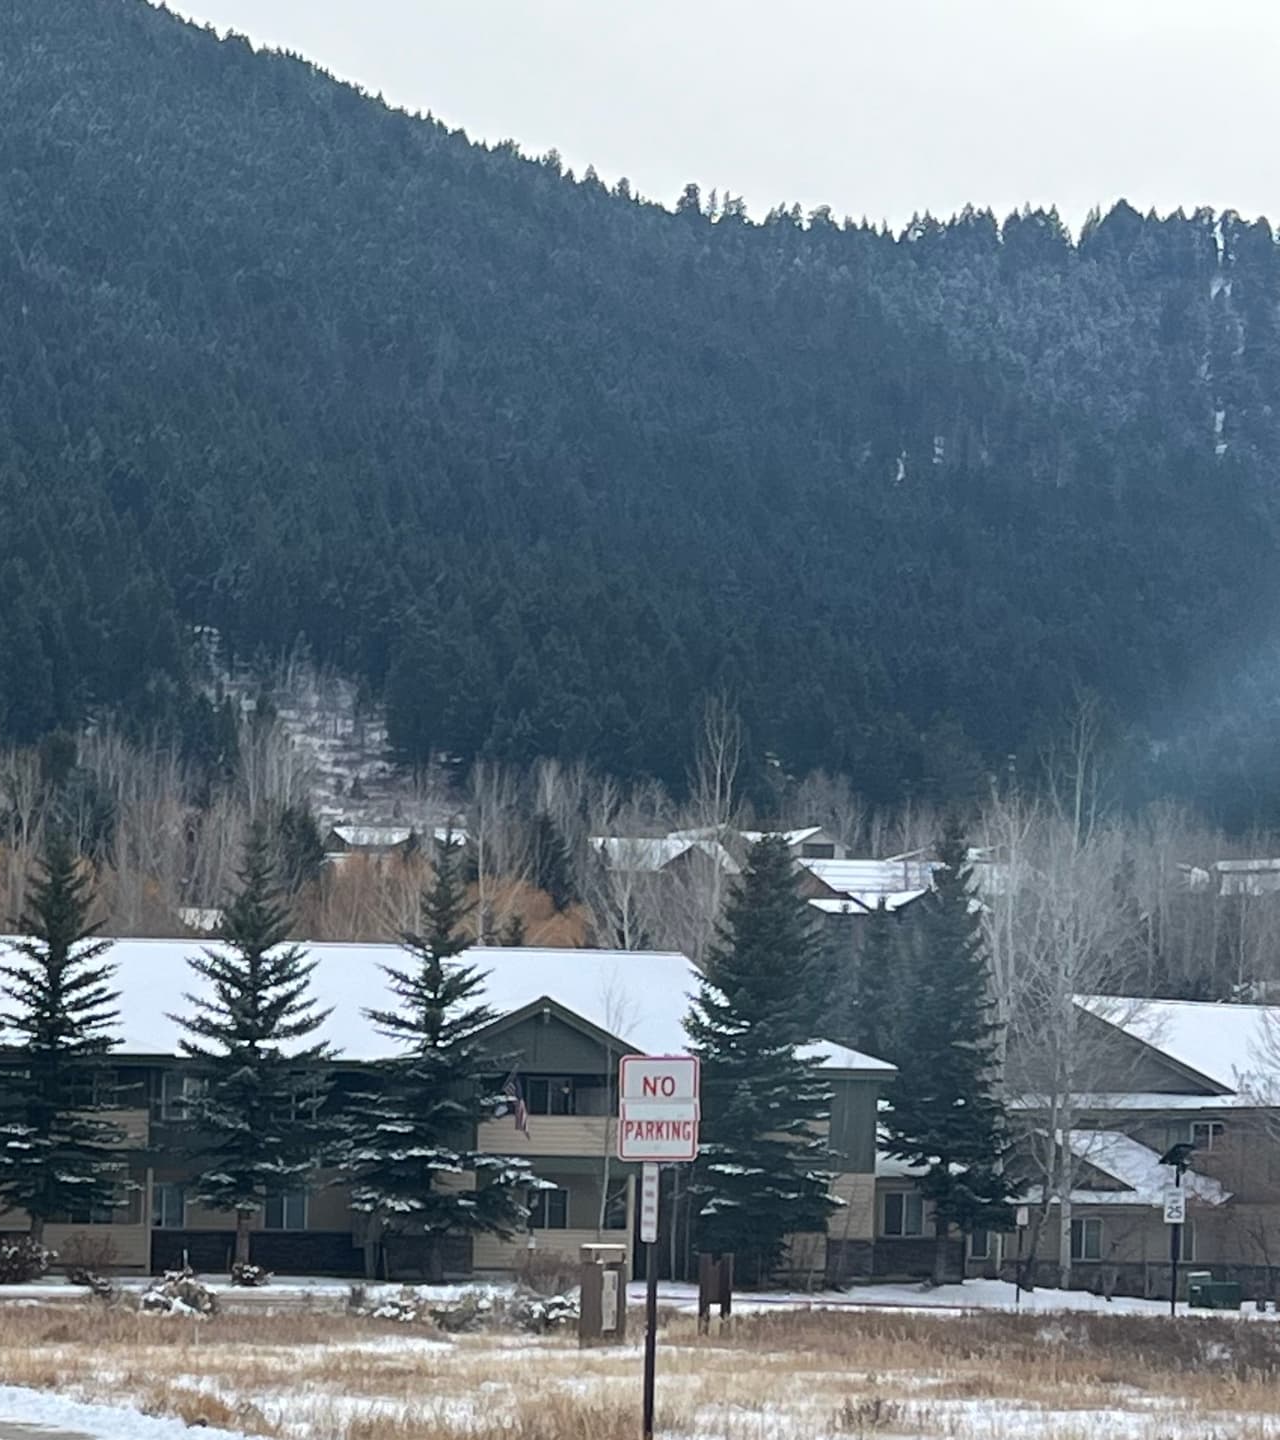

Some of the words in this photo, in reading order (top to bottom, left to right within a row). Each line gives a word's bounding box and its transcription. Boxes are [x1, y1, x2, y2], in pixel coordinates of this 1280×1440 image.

[642, 1075, 676, 1097] NO
[624, 1120, 691, 1141] PARKING
[1167, 1205, 1183, 1219] 25
